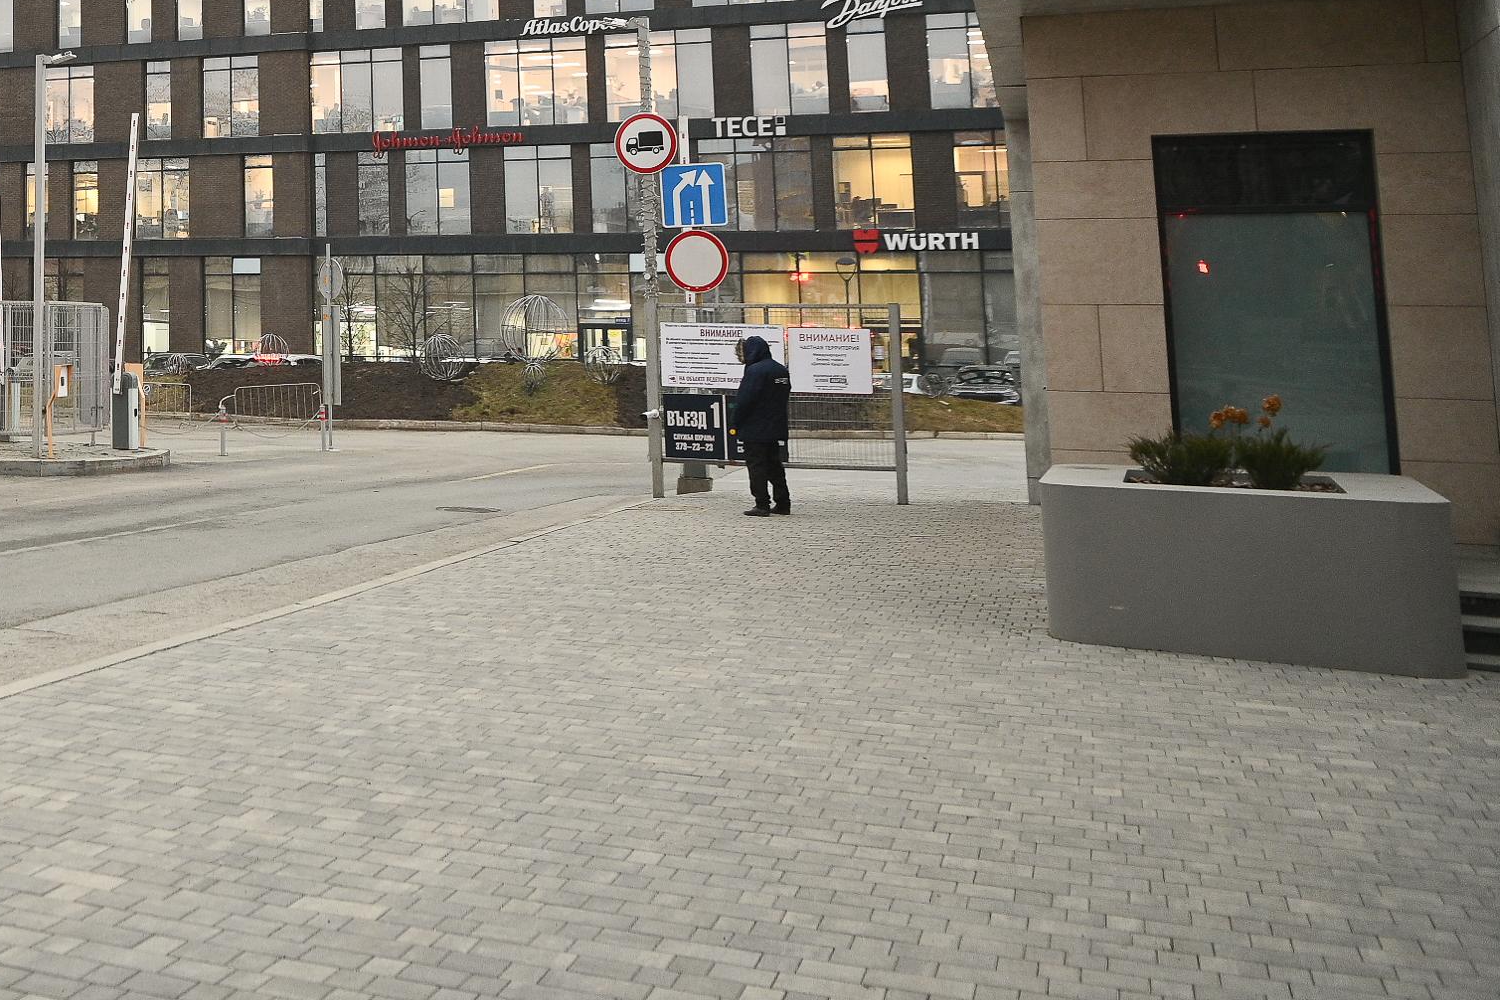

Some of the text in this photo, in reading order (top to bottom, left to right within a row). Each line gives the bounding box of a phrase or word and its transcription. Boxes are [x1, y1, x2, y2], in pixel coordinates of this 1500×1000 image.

[711, 116, 773, 138] TECE
[372, 130, 440, 159] Johnson
[450, 125, 525, 155] Johnson
[883, 232, 979, 251] WÜRTH
[798, 333, 860, 343] ВНИМАНИЕ!
[667, 402, 720, 430] ВЪЕЗД 1
